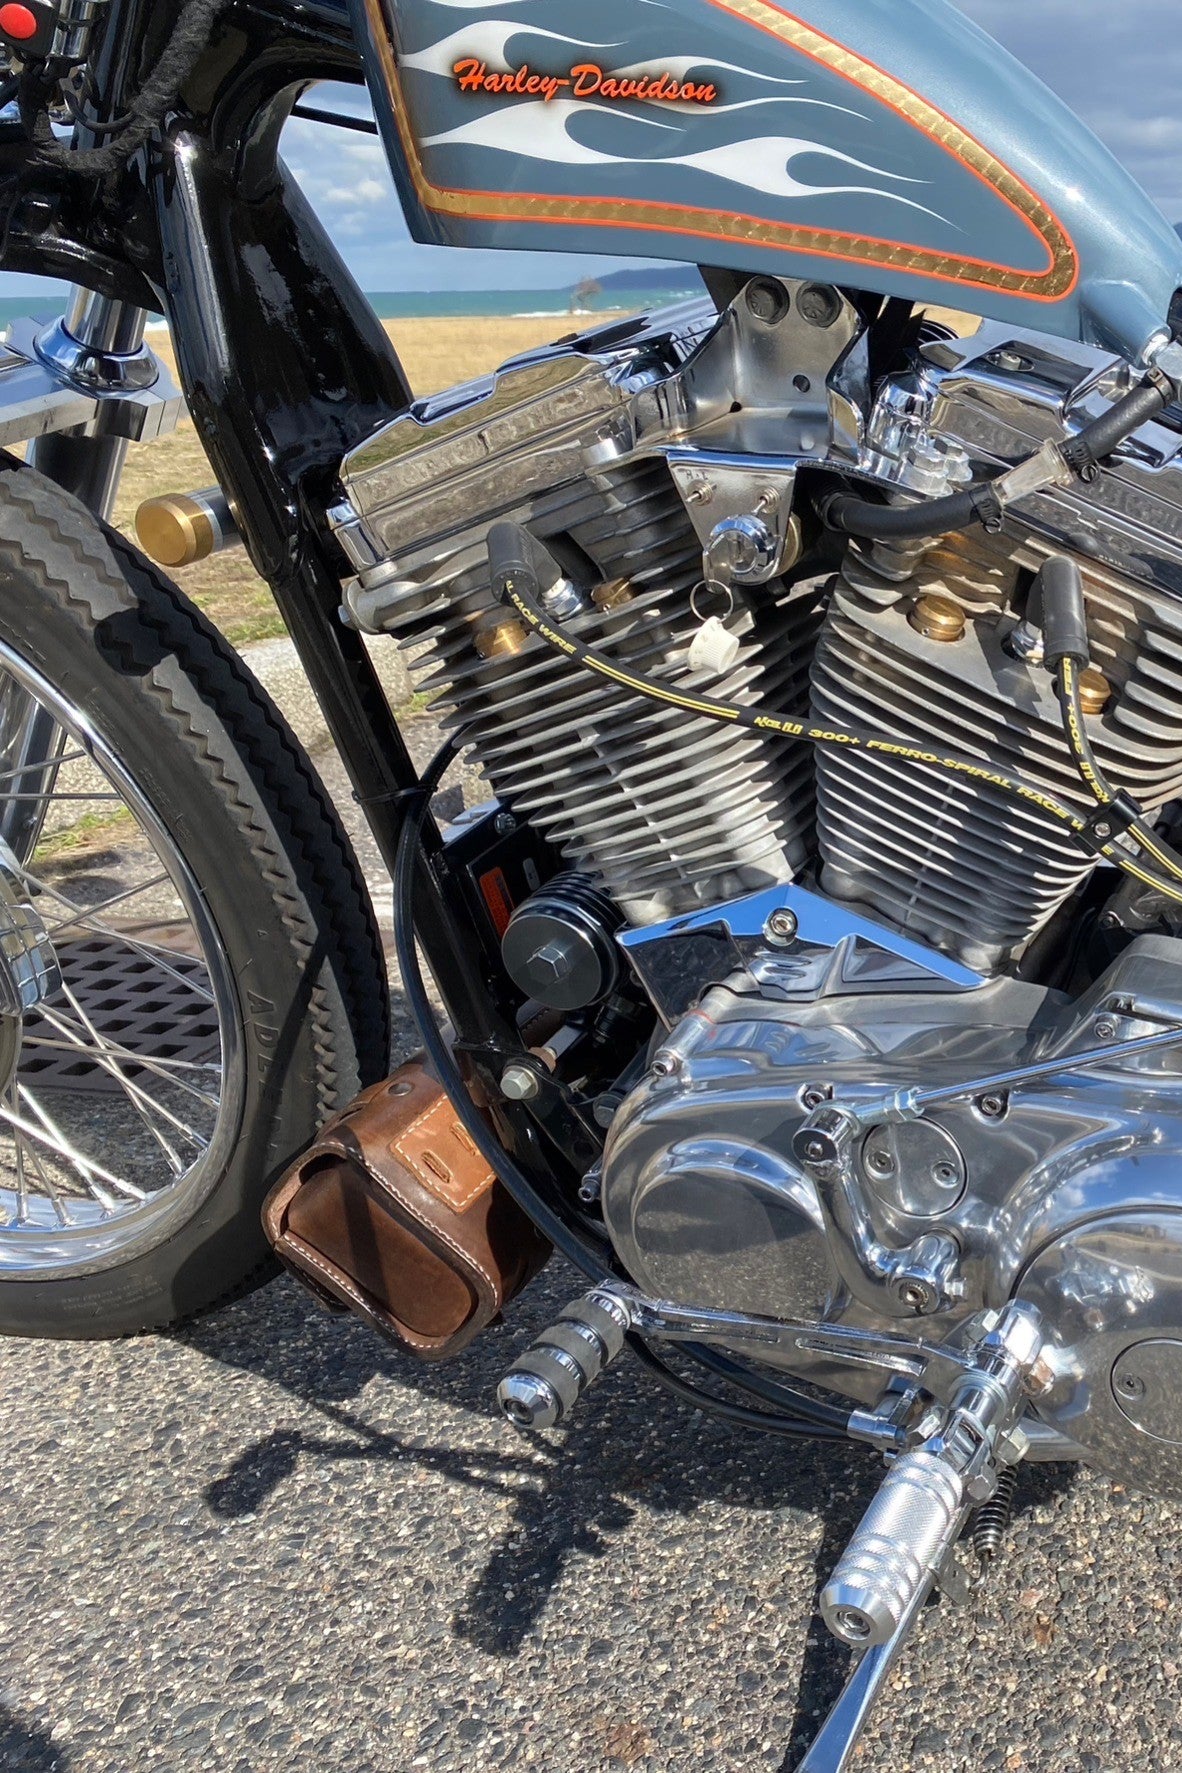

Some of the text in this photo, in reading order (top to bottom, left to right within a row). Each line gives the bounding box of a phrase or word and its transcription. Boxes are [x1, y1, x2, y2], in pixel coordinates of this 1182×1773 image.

[453, 58, 717, 102] Harley-Davidson
[511, 593, 539, 625] RACE
[538, 624, 577, 655] WIRE
[808, 729, 861, 745] 300+
[866, 739, 1012, 789] FERRO-SPIRAL
[1017, 787, 1070, 819] RACE
